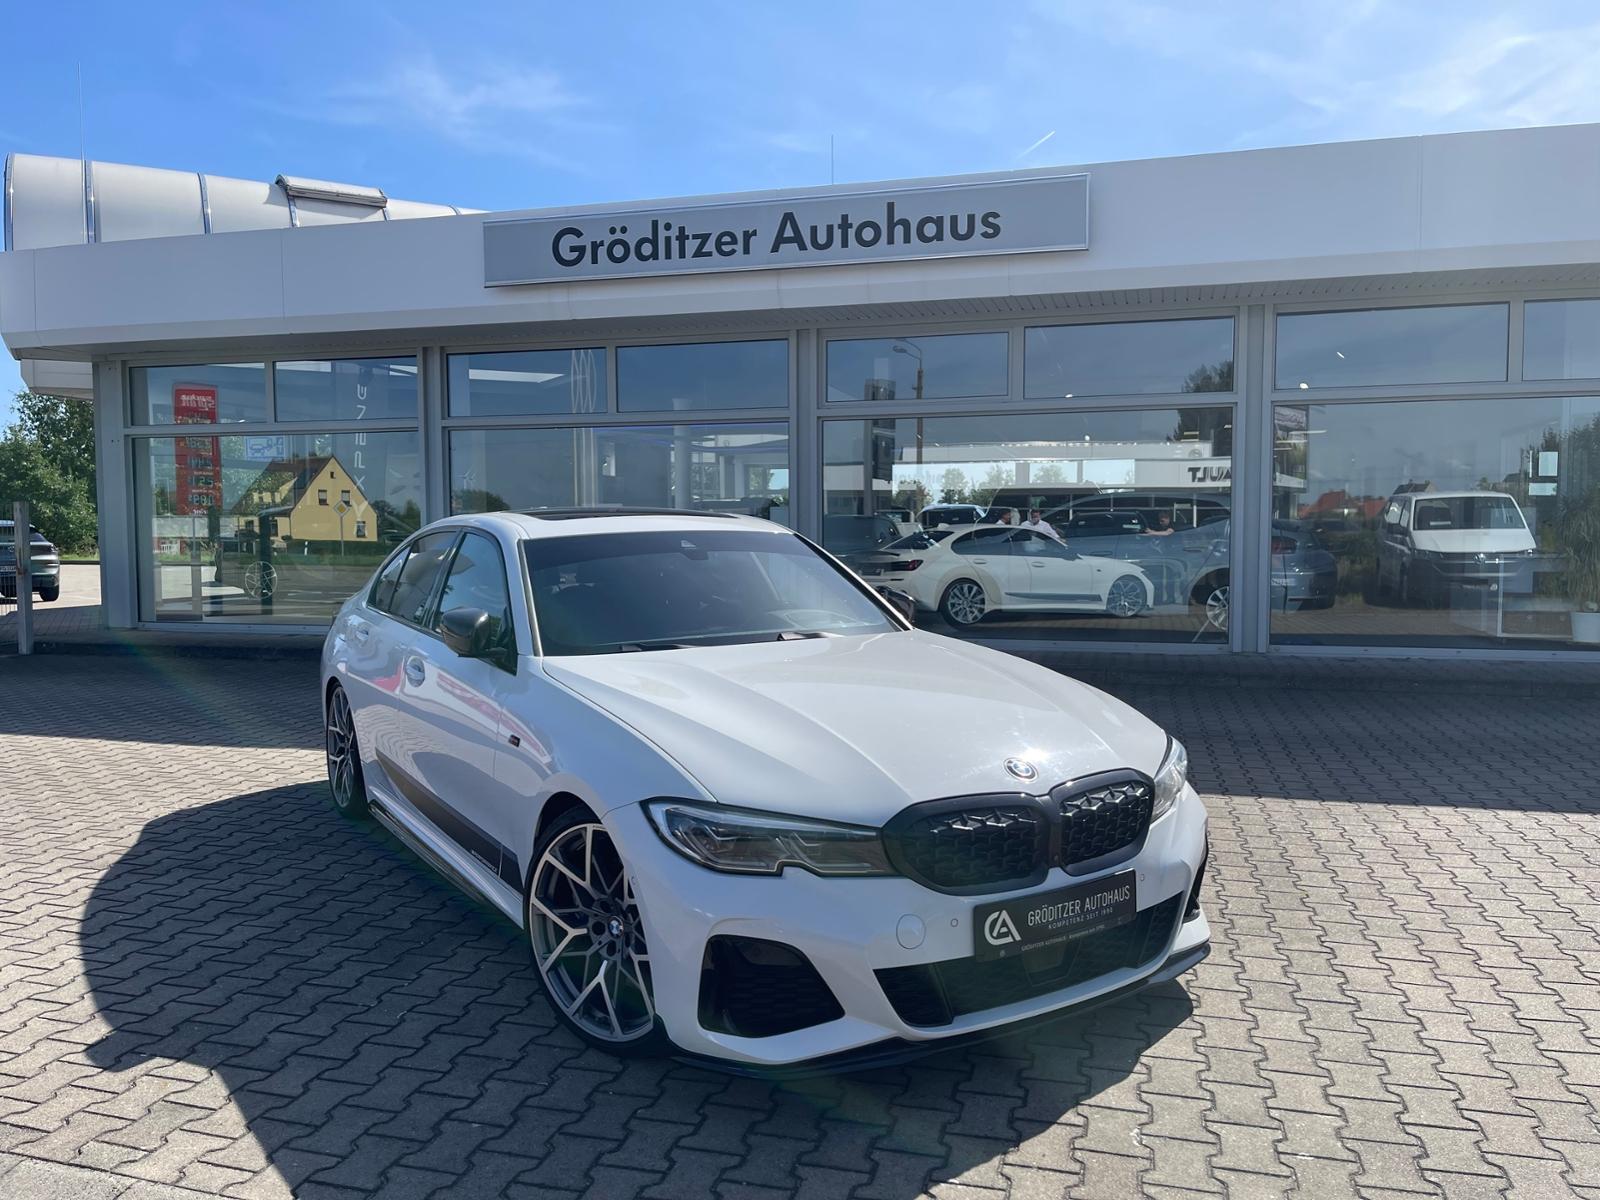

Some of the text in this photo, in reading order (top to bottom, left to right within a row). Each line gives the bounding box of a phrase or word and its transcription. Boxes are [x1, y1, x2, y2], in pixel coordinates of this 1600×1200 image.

[551, 202, 1001, 267] Gröditzer Autohaus
[1027, 885, 1131, 926] GRÖDITZER AUTOHAUS
